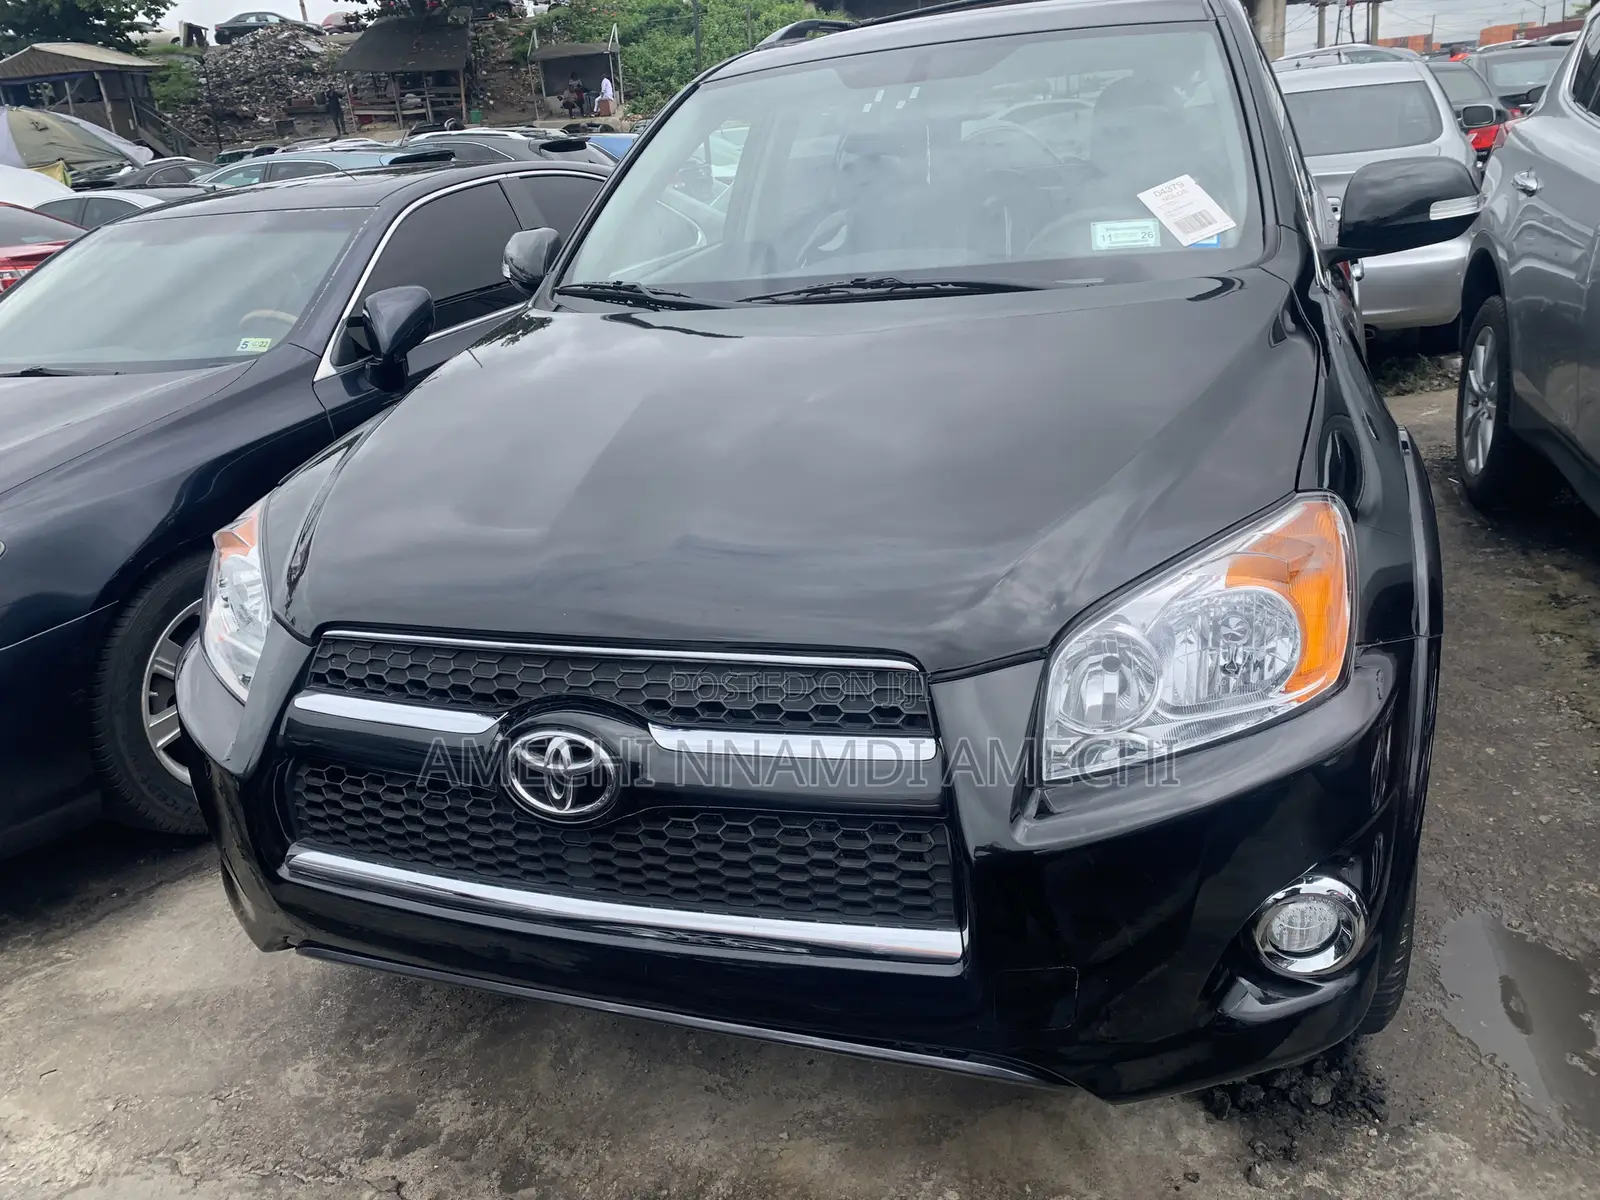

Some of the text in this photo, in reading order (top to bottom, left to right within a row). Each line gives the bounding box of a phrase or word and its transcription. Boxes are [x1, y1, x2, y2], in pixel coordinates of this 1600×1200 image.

[1153, 181, 1185, 197] 04379
[1101, 231, 1154, 242] 11 26
[241, 340, 250, 349] 5
